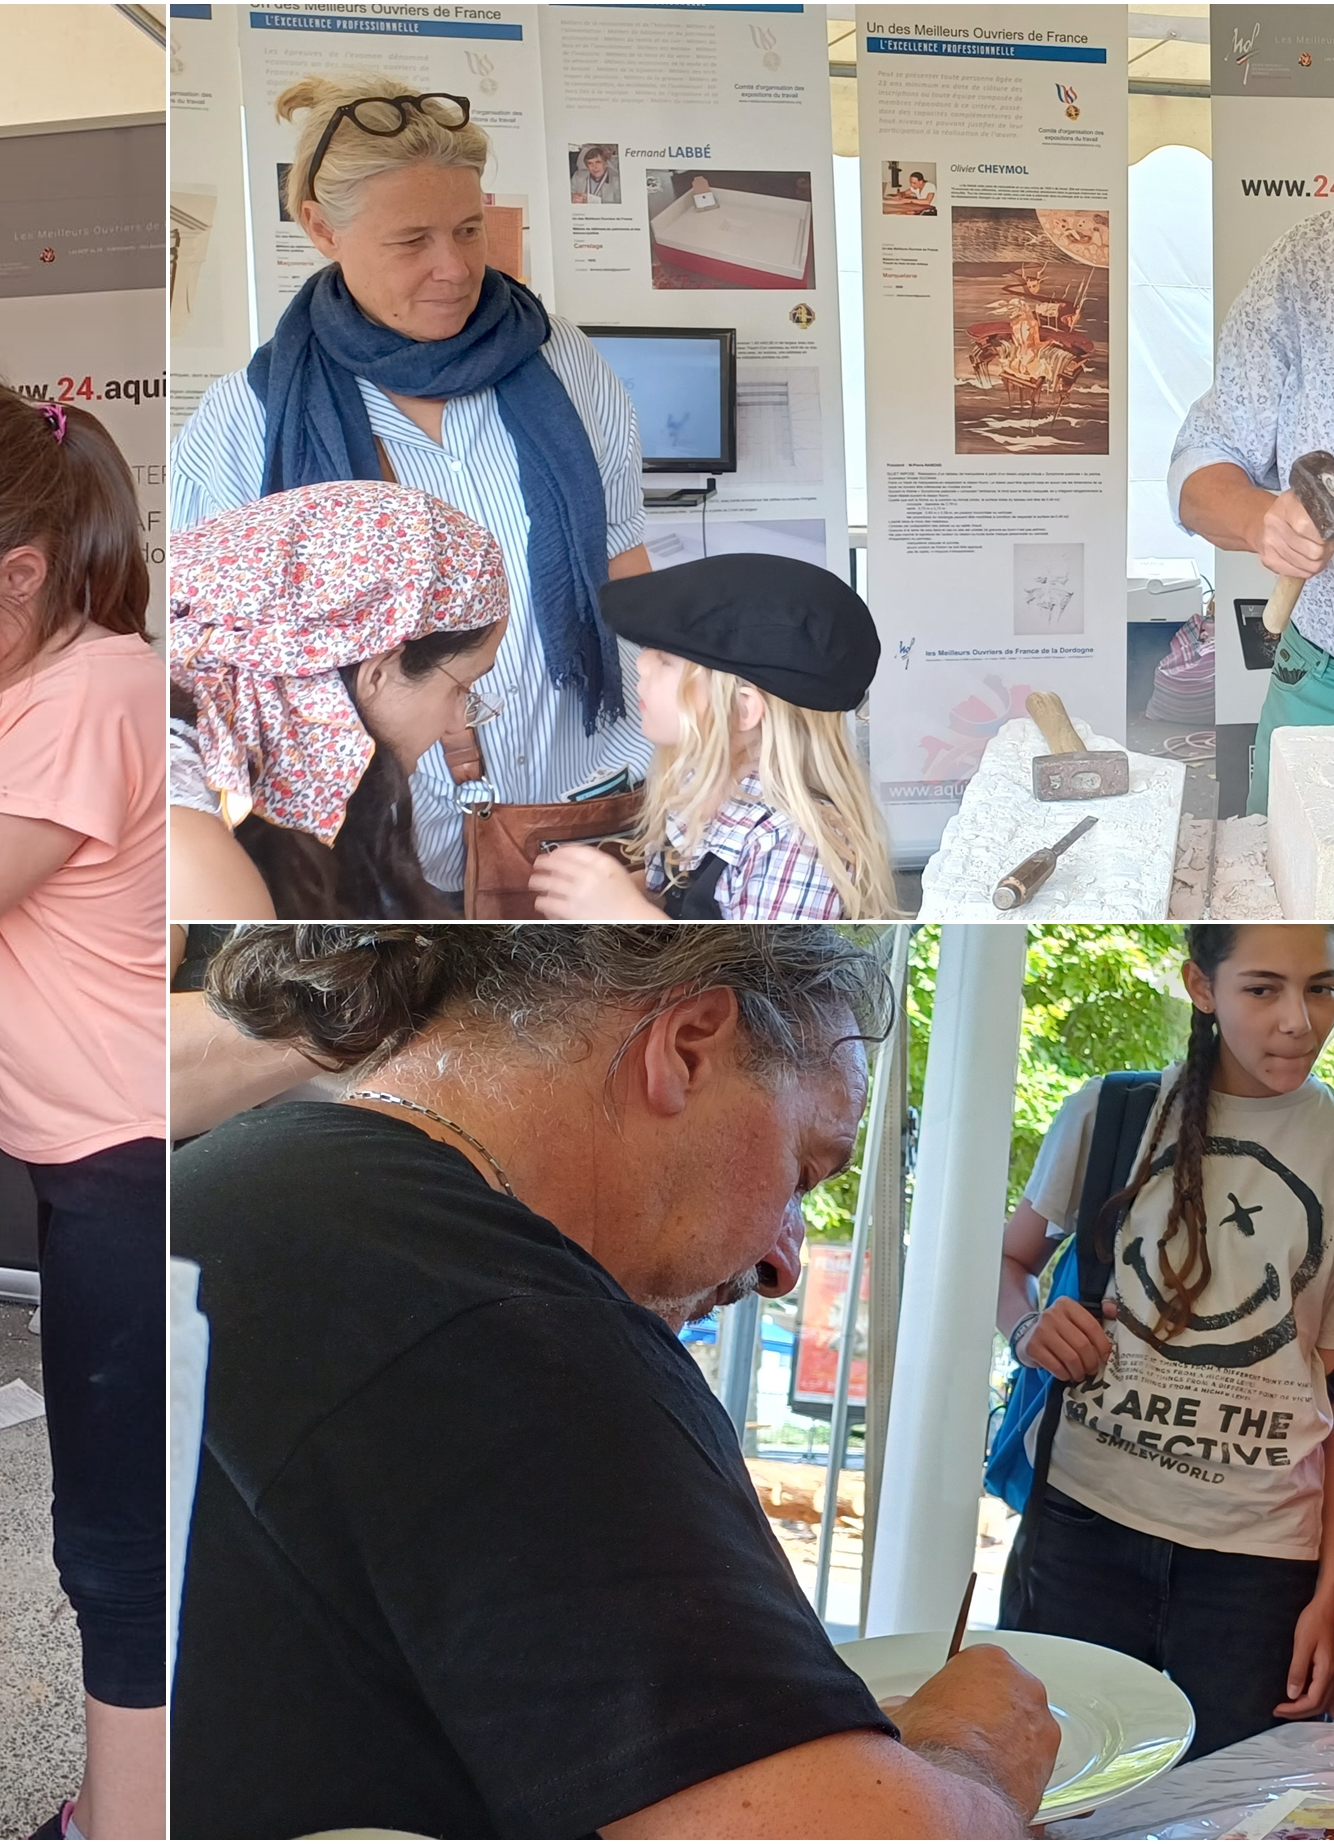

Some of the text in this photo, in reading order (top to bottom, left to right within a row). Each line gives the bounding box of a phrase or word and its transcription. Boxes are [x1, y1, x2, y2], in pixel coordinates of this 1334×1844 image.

[371, 4, 429, 16] Ouvriers
[433, 5, 451, 18] de
[455, 7, 502, 20] France
[867, 22, 1088, 44] Un des Meilleurs Ouvriers de France
[625, 144, 712, 158] Fernand LABBÉ
[951, 164, 1029, 175] Olivier CHEYMOL
[1005, 648, 1013, 656] de
[1060, 646, 1094, 655] Dordogne
[1110, 1388, 1201, 1428] ARE
[1218, 1403, 1294, 1440] THE
[1096, 1432, 1225, 1485] SMILEYWORLD
